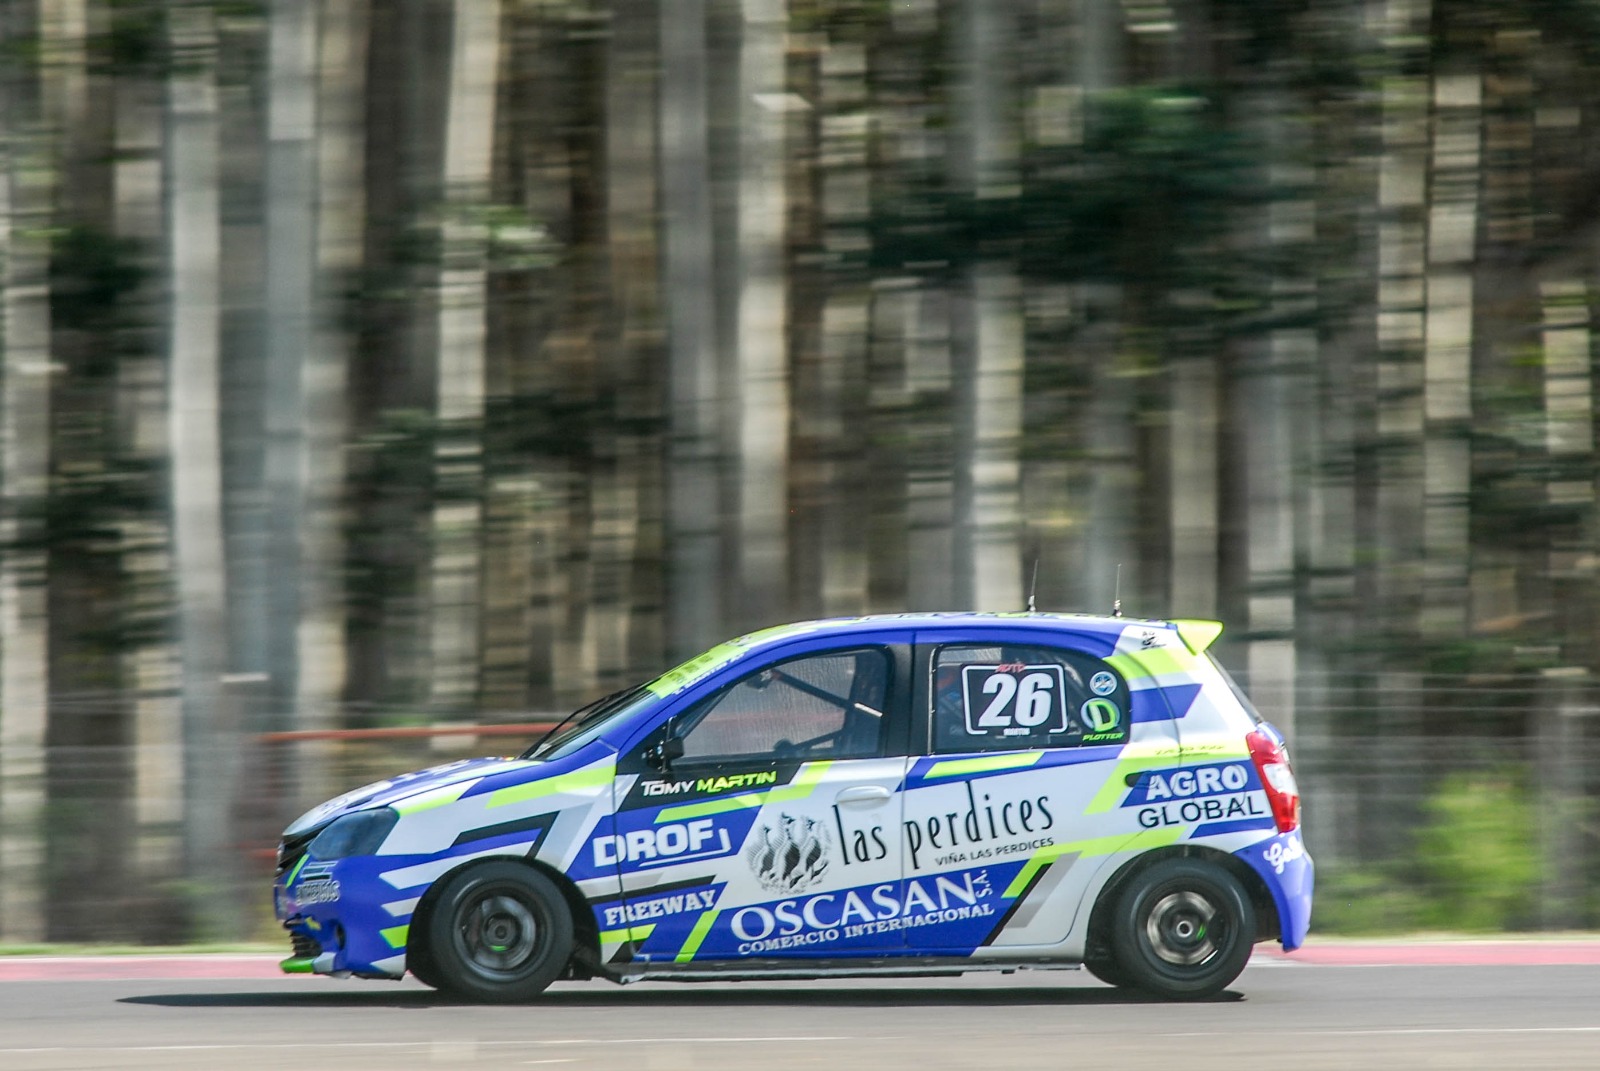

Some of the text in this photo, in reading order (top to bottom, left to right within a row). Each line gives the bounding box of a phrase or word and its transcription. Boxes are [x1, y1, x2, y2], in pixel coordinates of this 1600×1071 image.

[978, 672, 1054, 727] 26
[1082, 732, 1124, 742] PLOTTER
[641, 771, 777, 797] TOMY MARTIN
[1145, 764, 1249, 801] AGRO
[832, 780, 1054, 870] las perdices
[1138, 796, 1264, 829] GLOBAL
[593, 818, 714, 868] DROF
[935, 836, 1055, 867] VIÑA LAS PERDICES
[972, 869, 993, 898] S.A.
[604, 889, 716, 926] FREEWAY
[730, 872, 977, 942] OSCASAN
[738, 903, 995, 955] COMERCIO INTERNACIONAL
